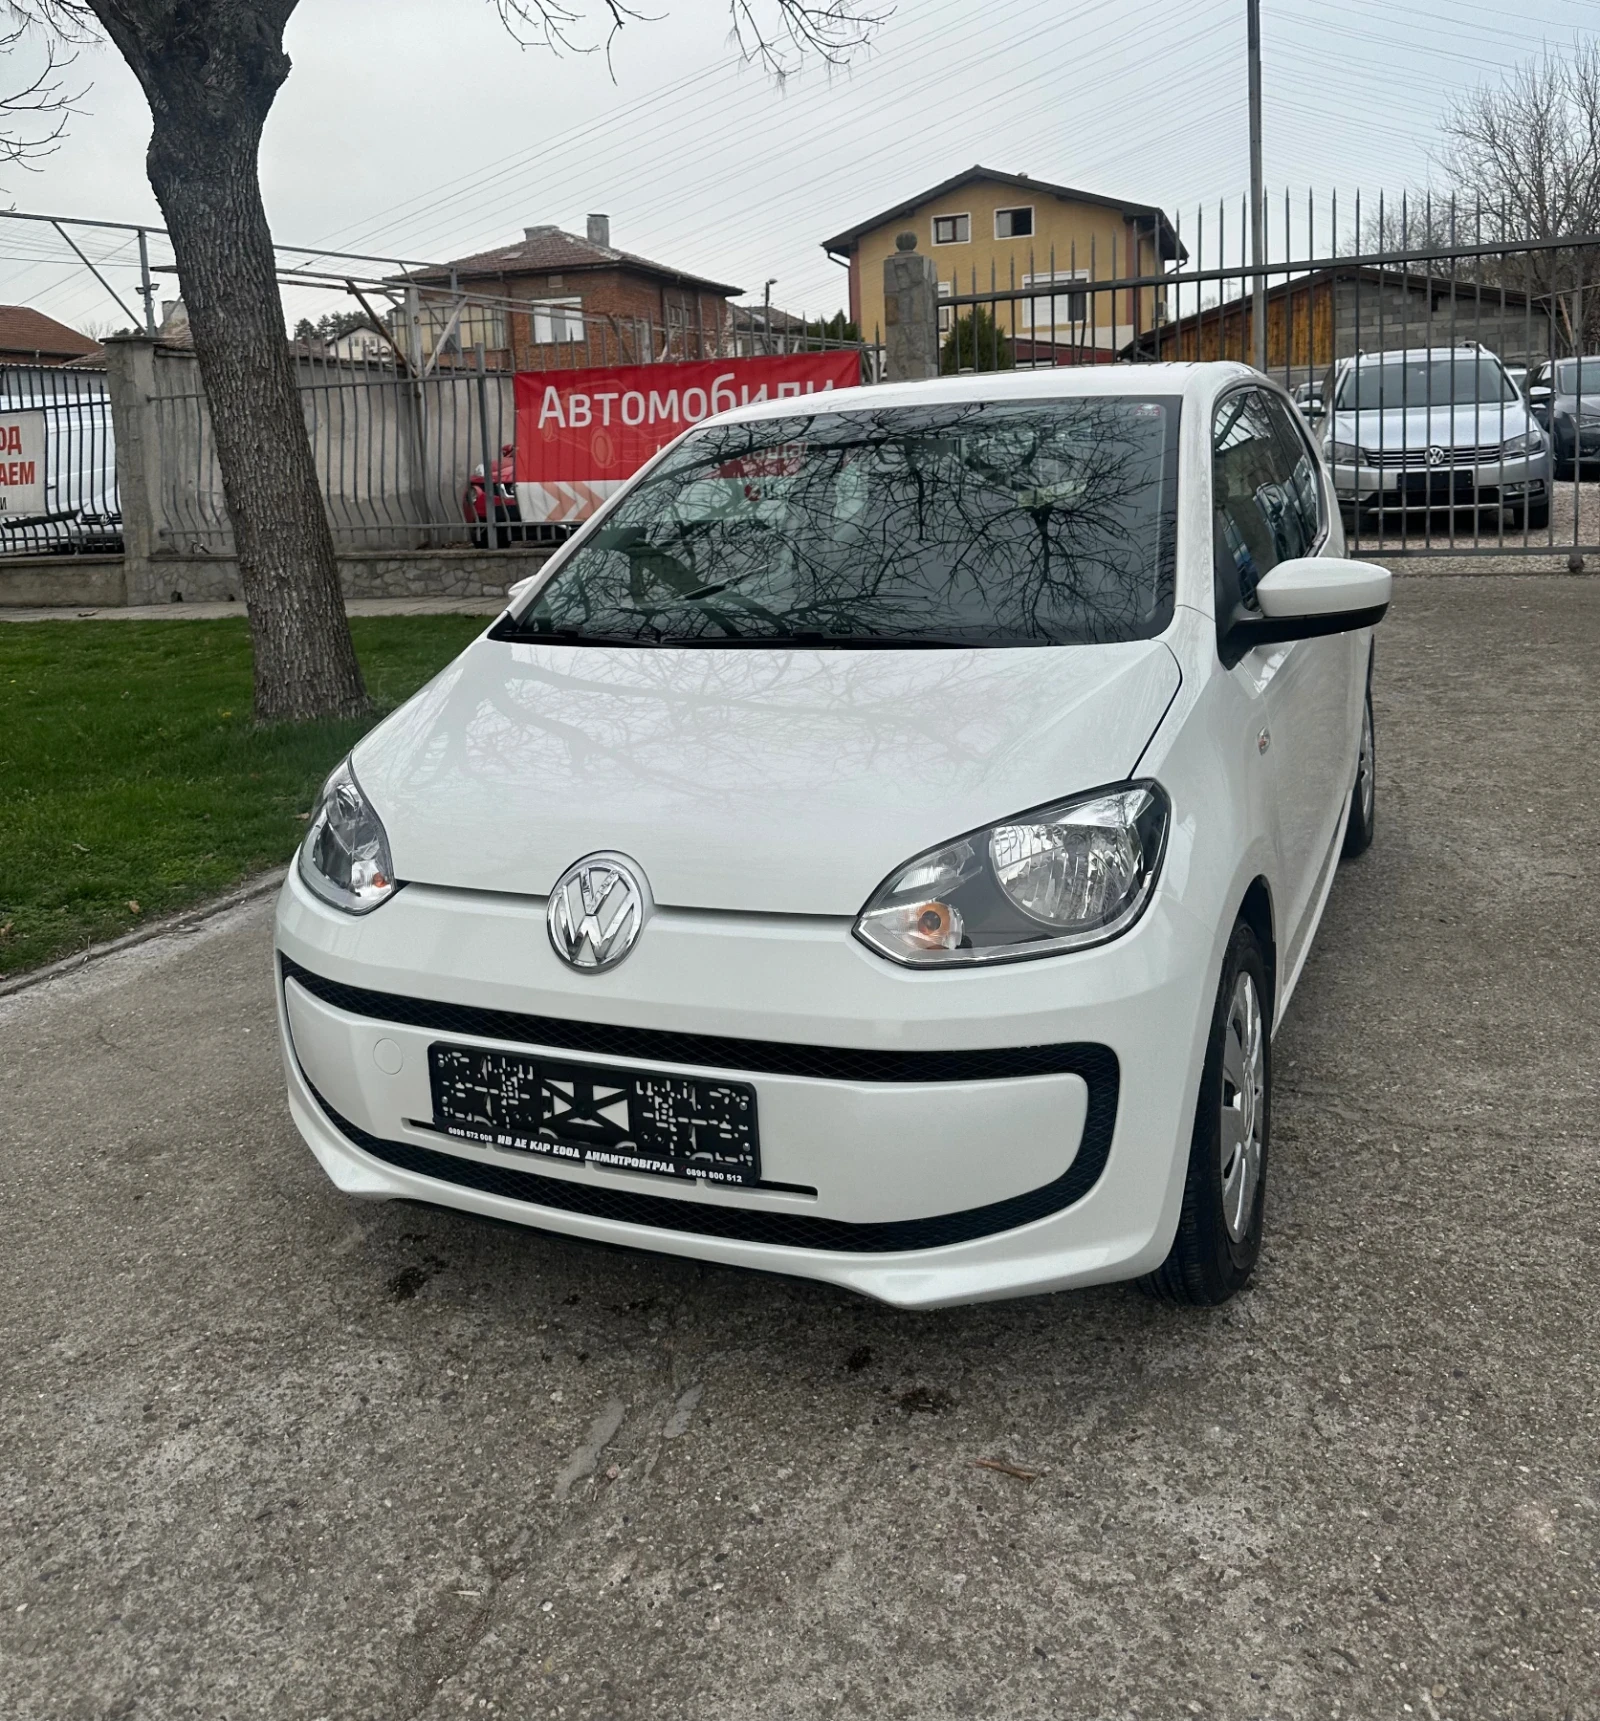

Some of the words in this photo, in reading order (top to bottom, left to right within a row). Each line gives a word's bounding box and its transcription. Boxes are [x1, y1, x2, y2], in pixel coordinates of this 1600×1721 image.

[529, 1140, 551, 1152] КАР
[585, 1150, 675, 1173] ДИМИТРОВГРАД
[726, 1174, 743, 1183] 512
